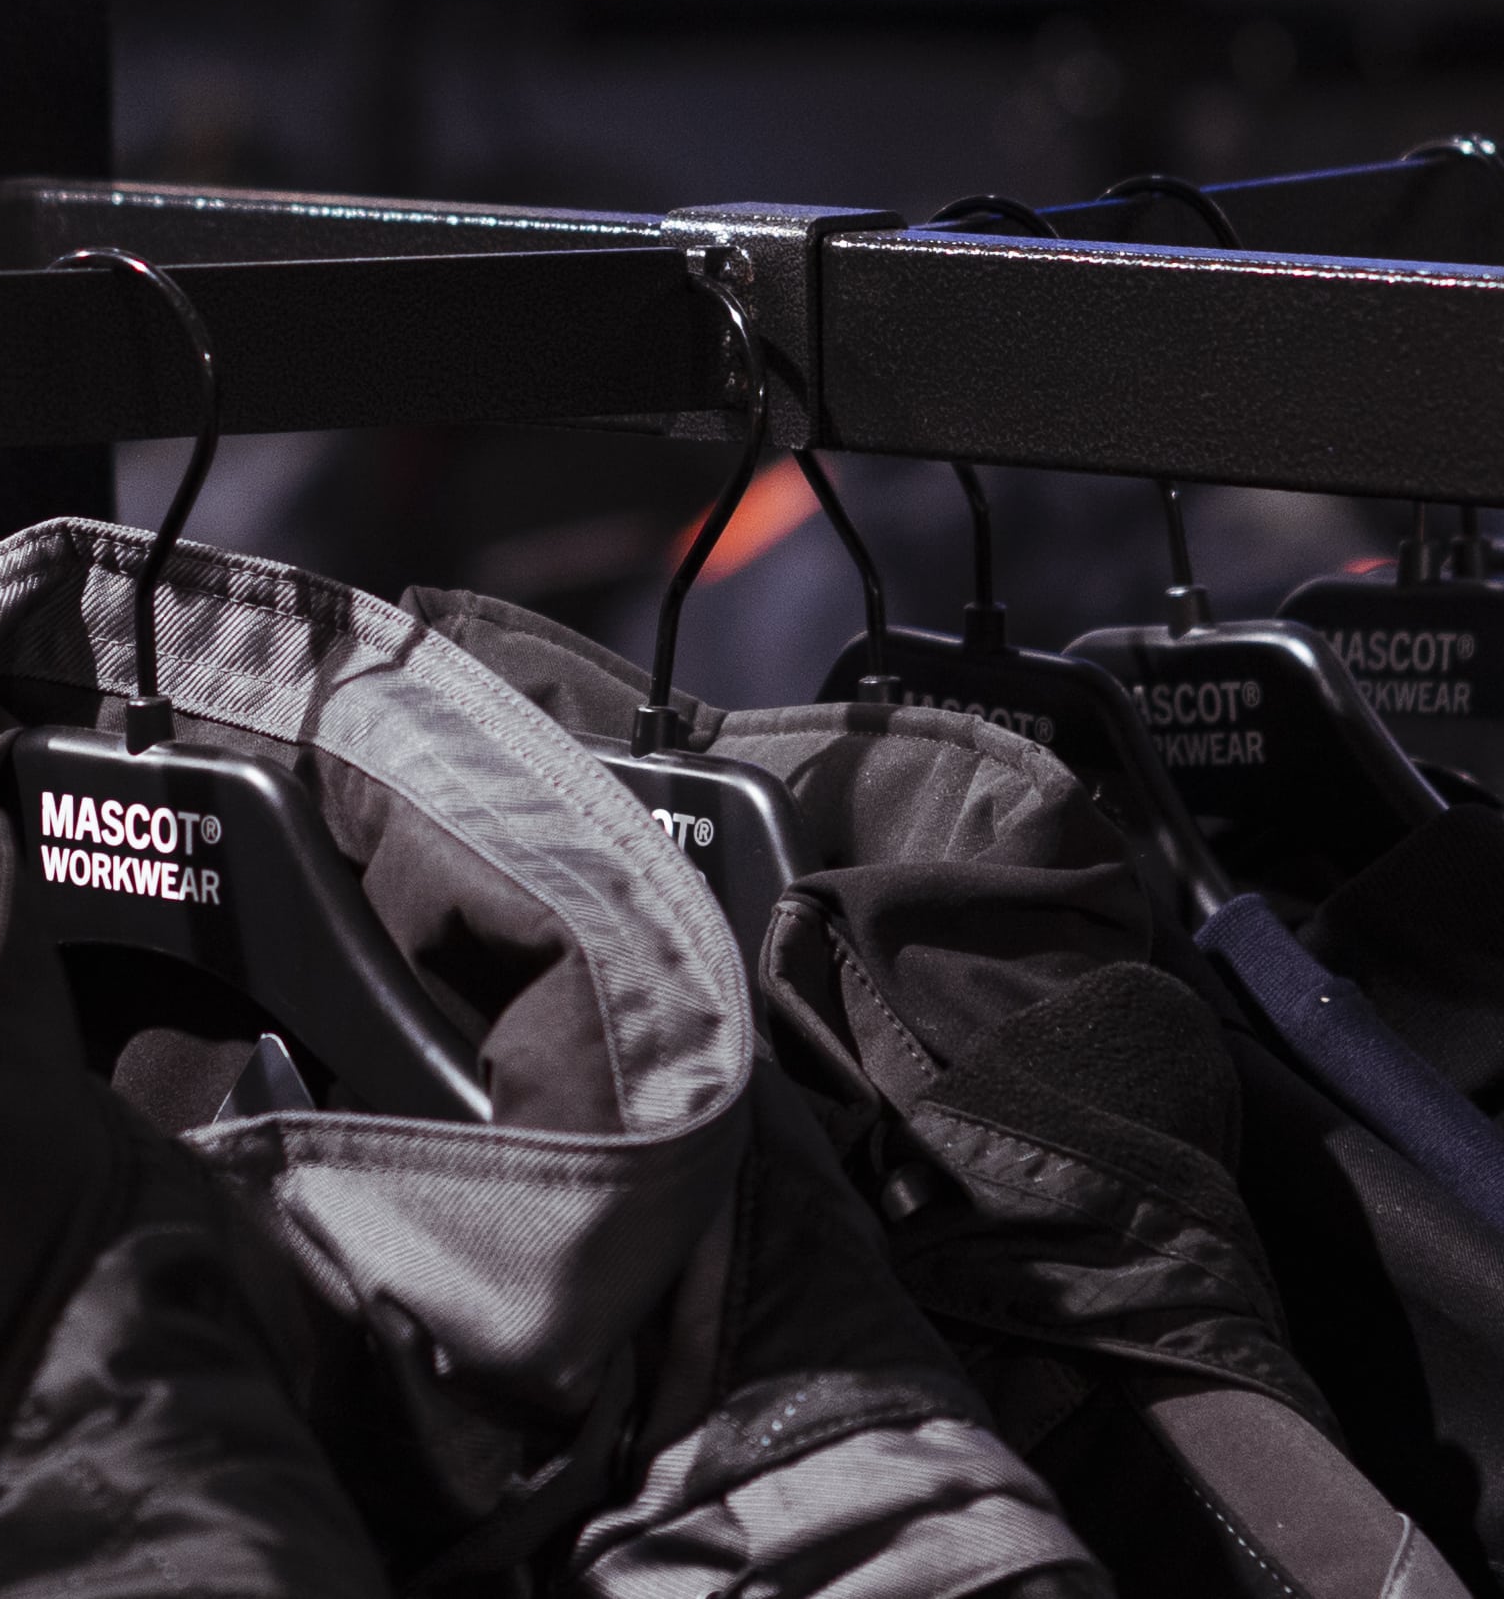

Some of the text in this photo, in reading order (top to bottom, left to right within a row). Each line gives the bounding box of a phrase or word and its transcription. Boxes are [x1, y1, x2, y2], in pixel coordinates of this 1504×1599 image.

[1133, 680, 1262, 725] ASCOT®
[1357, 680, 1471, 714] RKWEAR
[41, 791, 223, 856] MASCOT®
[40, 844, 221, 906] WORKWEAR
